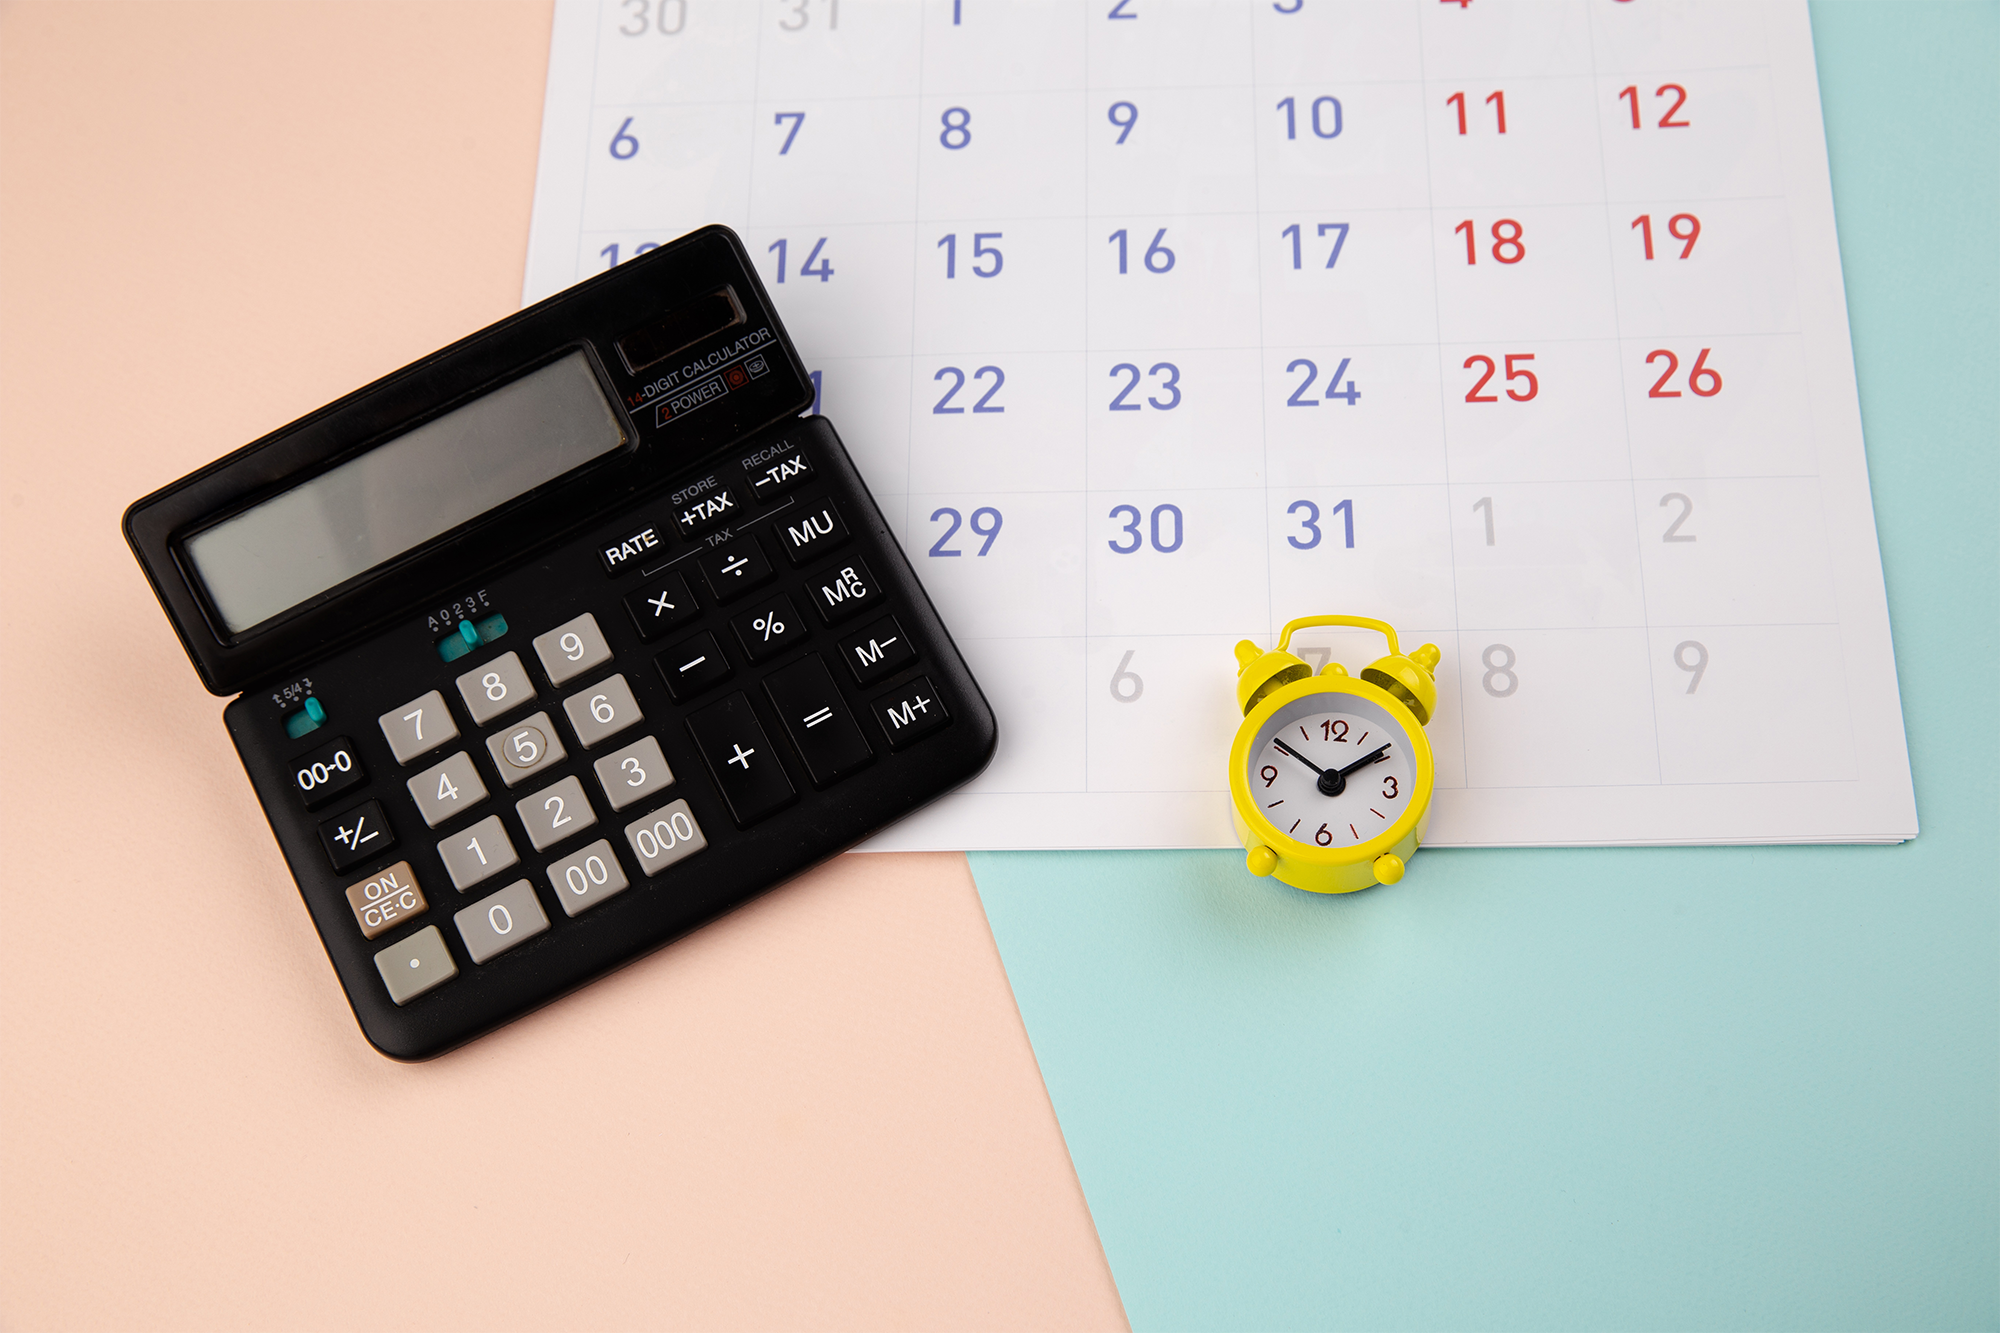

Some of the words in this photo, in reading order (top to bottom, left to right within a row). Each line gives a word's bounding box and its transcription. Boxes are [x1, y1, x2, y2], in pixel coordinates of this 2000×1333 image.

[620, 0, 687, 37] 30
[608, 116, 640, 160] 6
[773, 111, 806, 155] 7
[939, 106, 972, 150] 8
[1107, 101, 1139, 145] 9
[1275, 95, 1344, 140] 10
[1445, 90, 1508, 136] 11
[1618, 83, 1692, 130] 12
[768, 236, 835, 285] 14
[937, 231, 1004, 280] 15
[1108, 227, 1177, 275] 16
[1281, 222, 1350, 270] 17
[1454, 218, 1527, 266] 18
[1630, 212, 1702, 261] 19
[627, 370, 681, 407] 14-DIGIT
[682, 327, 772, 379] CALCULATOR
[932, 365, 1006, 415] 22
[1108, 362, 1182, 411] 23
[1285, 357, 1362, 407] 24
[1462, 353, 1540, 403] 25
[1644, 348, 1724, 399] 26
[661, 406, 673, 421] 2
[671, 381, 722, 414] POWER
[741, 439, 795, 471] RECALL
[671, 475, 718, 506] STORE
[680, 491, 734, 526] +TAX
[928, 506, 1003, 557] 29
[1107, 503, 1184, 555] 30
[1286, 499, 1356, 551] 31
[1472, 497, 1496, 546] 1
[1659, 492, 1698, 543] 2
[705, 528, 734, 548] TAX
[787, 510, 834, 547] MU
[605, 528, 659, 566] RATE
[428, 615, 439, 628] A
[452, 602, 464, 615] 2
[465, 596, 476, 608] 3
[477, 589, 488, 602] F
[559, 632, 584, 661] 9
[482, 672, 507, 701] 8
[1109, 650, 1144, 703] 6
[1481, 643, 1520, 698] 8
[1673, 640, 1710, 695] 9
[282, 682, 303, 699] 5/4
[403, 708, 424, 741] 7
[590, 694, 615, 723] 6
[886, 695, 931, 729] M+
[513, 731, 539, 762] 5
[1320, 719, 1350, 743] 12
[437, 772, 459, 800] 4
[621, 757, 647, 787] 3
[1260, 765, 1278, 788] 9
[1382, 776, 1399, 800] 3
[544, 796, 572, 829] 2
[466, 837, 488, 866] 1
[636, 812, 694, 858] 000
[1315, 823, 1333, 847] 6
[363, 872, 399, 901] ON
[565, 855, 609, 895] 00
[488, 904, 513, 935] 0
